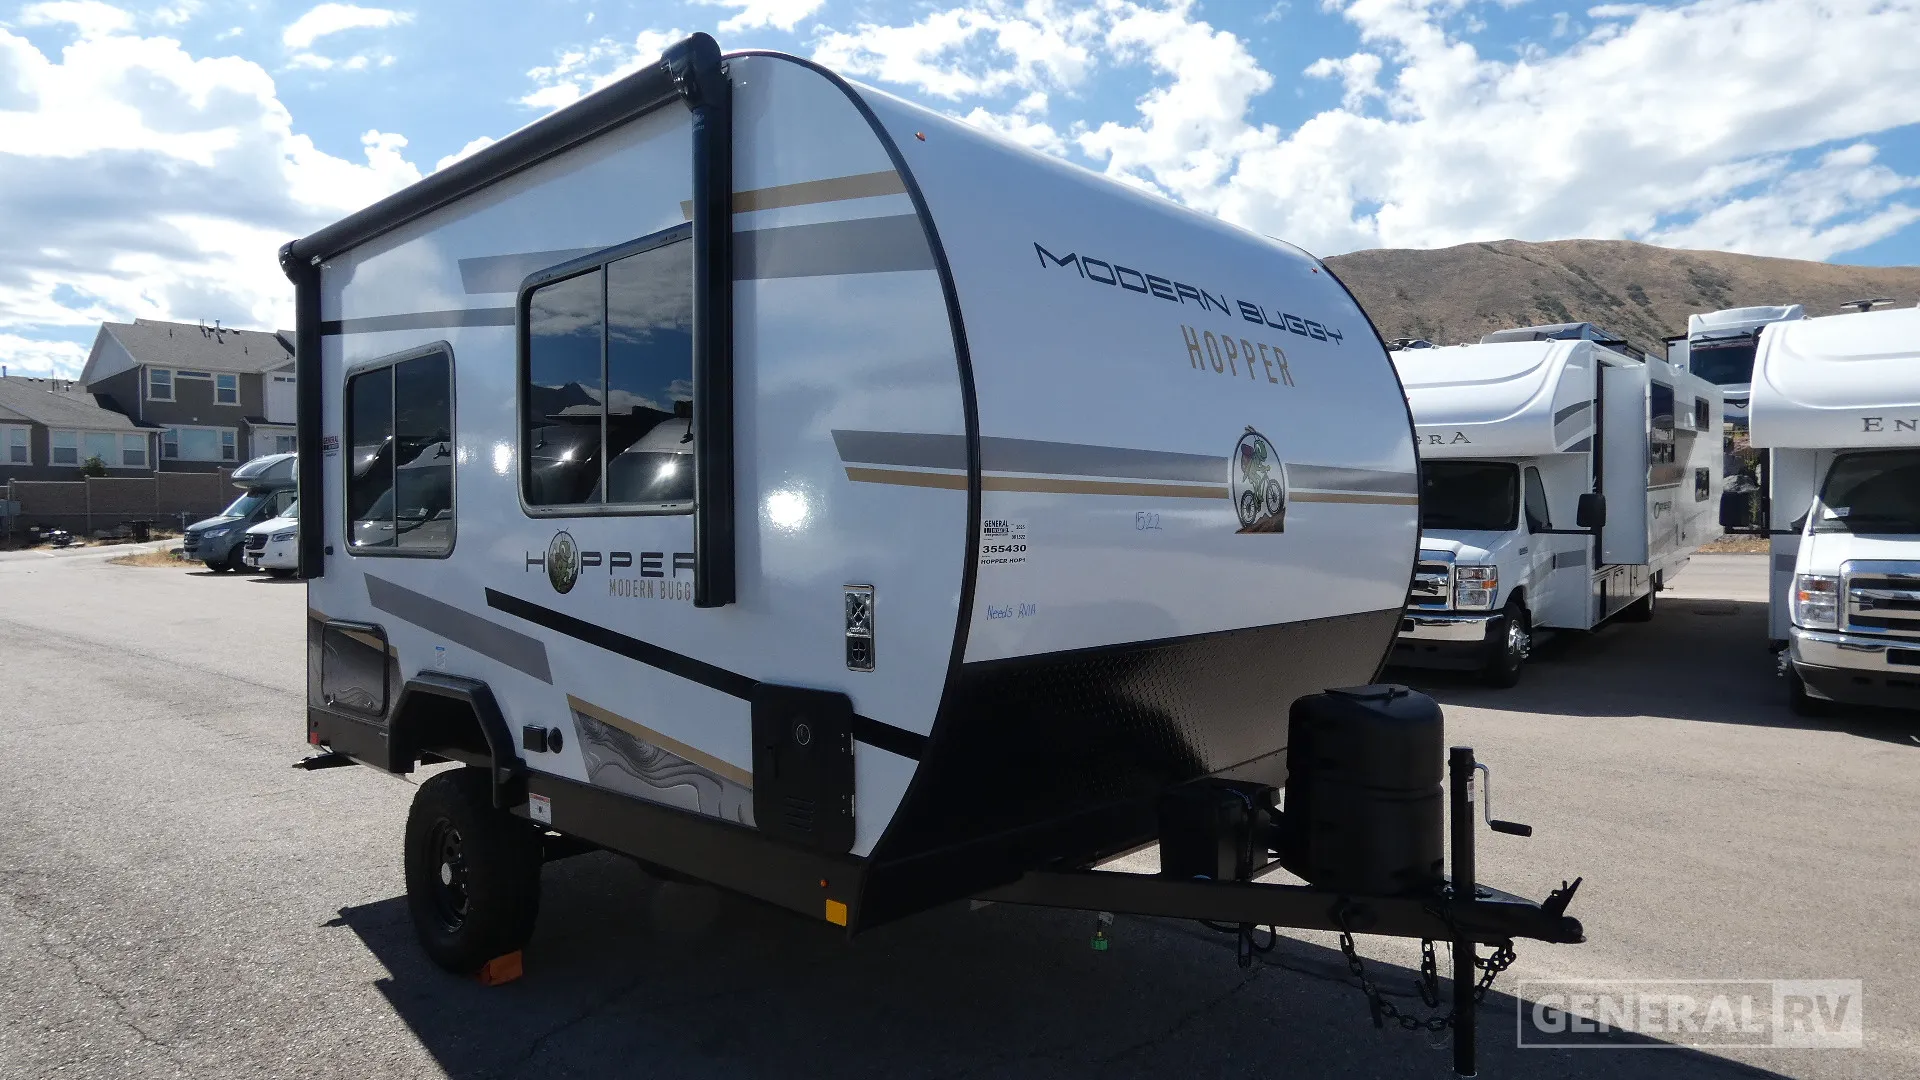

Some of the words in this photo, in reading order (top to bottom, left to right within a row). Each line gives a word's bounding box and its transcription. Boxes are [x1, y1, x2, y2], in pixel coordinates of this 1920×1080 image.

[1034, 242, 1232, 317] MODERN
[1236, 299, 1344, 346] BUGGY
[1180, 324, 1296, 388] HOPPER
[1860, 417, 1919, 432] EN
[984, 520, 1009, 528] GENERAL
[983, 544, 1027, 554] 355430
[609, 579, 654, 599] MODERN
[659, 581, 691, 601] BUGG
[986, 604, 1013, 621] Needs
